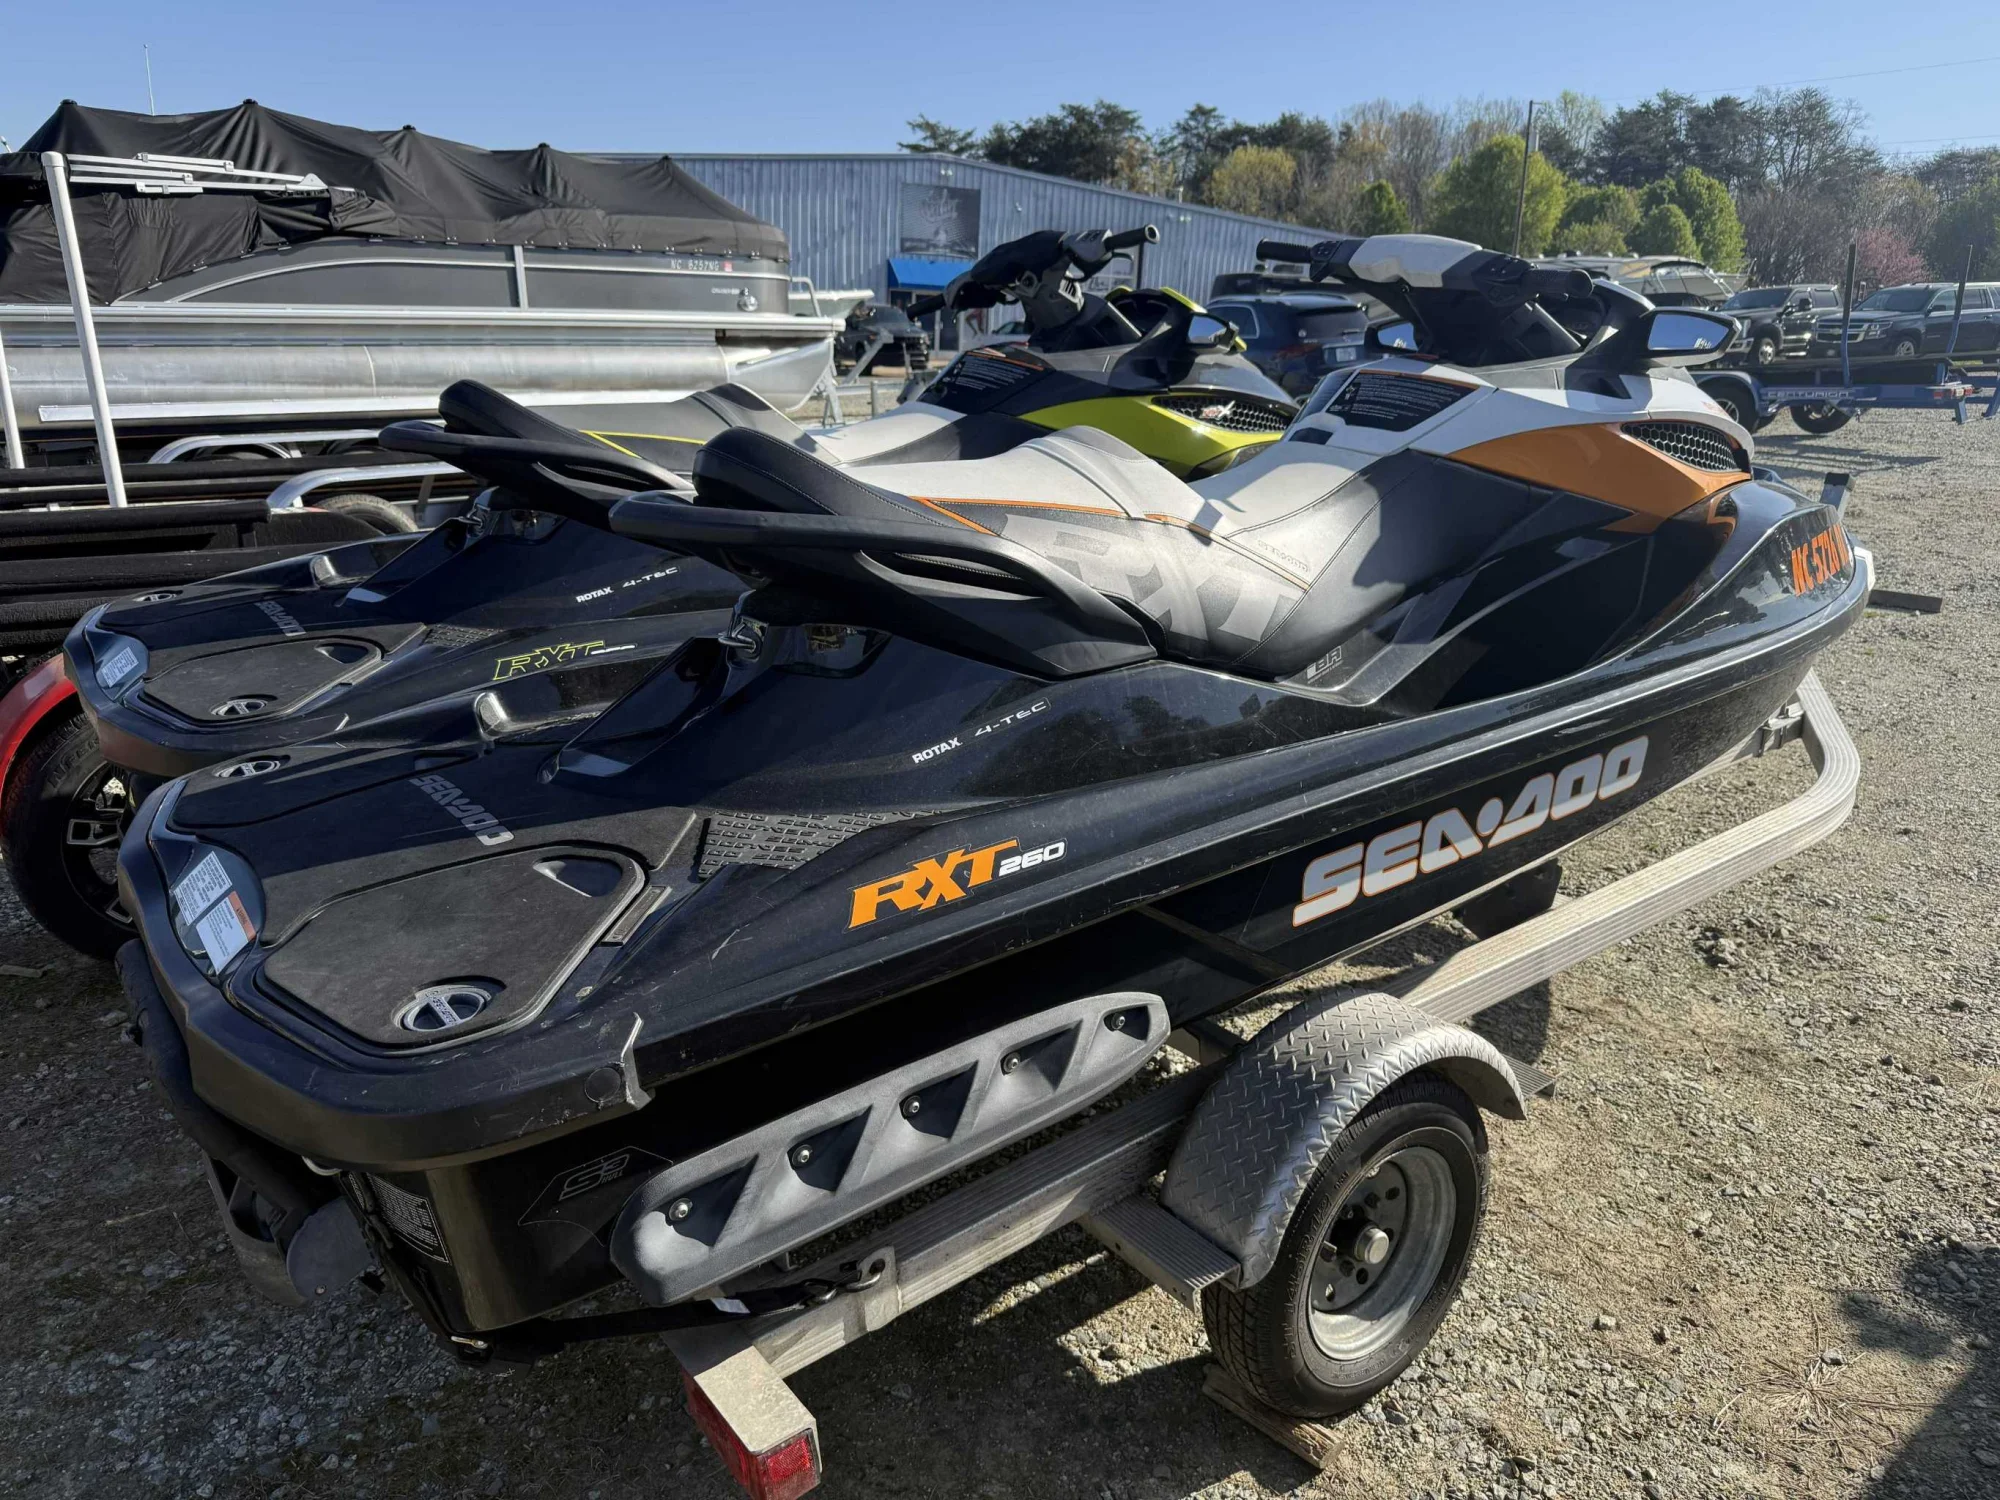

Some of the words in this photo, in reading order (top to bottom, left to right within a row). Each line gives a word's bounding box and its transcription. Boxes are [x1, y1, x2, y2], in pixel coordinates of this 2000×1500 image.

[670, 259, 682, 270] NC
[1767, 390, 1850, 399] CENTURION
[575, 586, 615, 603] ROTAX
[622, 566, 679, 588] 4-TEC
[1791, 543, 1815, 597] NC
[493, 640, 604, 681] RXT
[911, 737, 963, 764] ROTAX
[974, 701, 1047, 737] 4-TEC
[849, 839, 1018, 929] RXT
[999, 841, 1066, 877] 260
